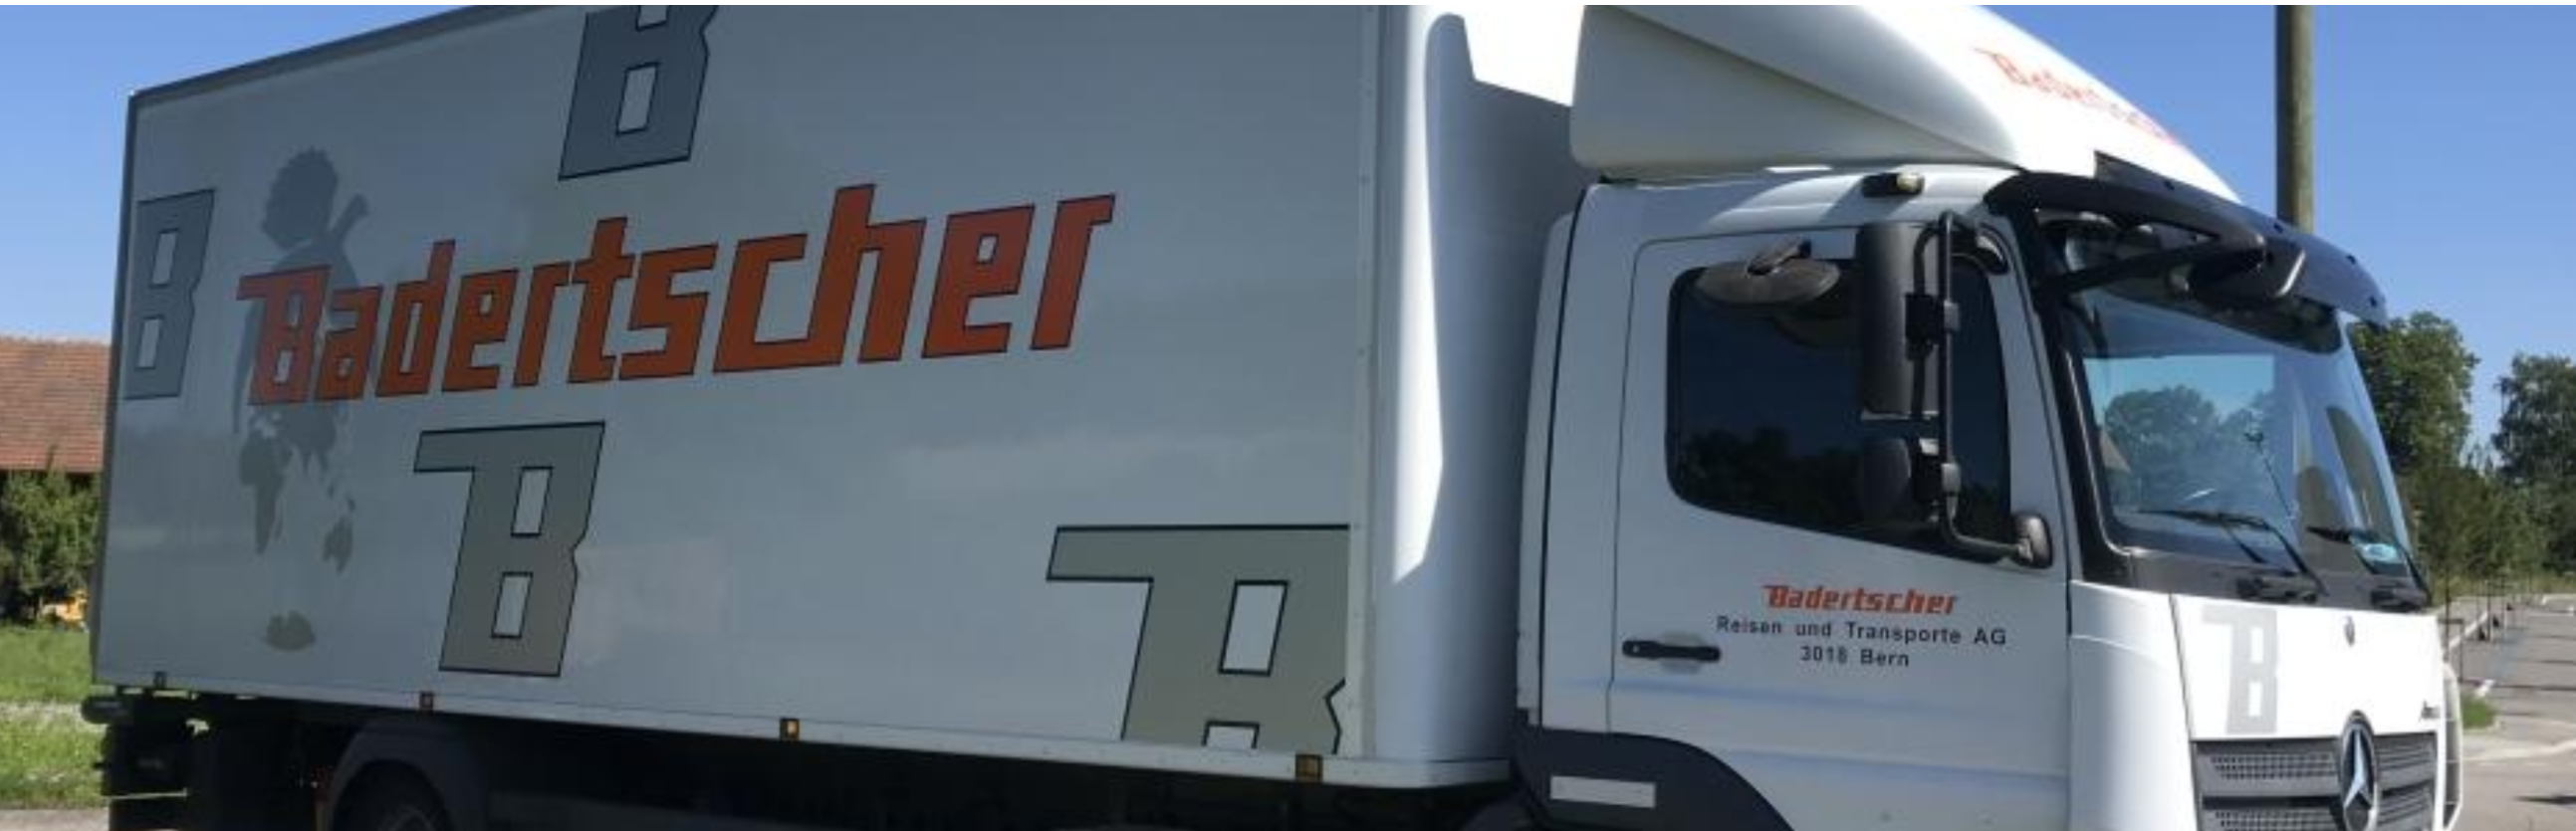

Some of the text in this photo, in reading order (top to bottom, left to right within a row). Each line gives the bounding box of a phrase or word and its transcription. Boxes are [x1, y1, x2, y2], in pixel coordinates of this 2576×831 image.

[236, 183, 1115, 405] Badertscher
[1762, 584, 1958, 615] Badertscher
[1717, 615, 2007, 646] Reisen und Transporte AG
[1800, 645, 1910, 667] 3018 Bern
